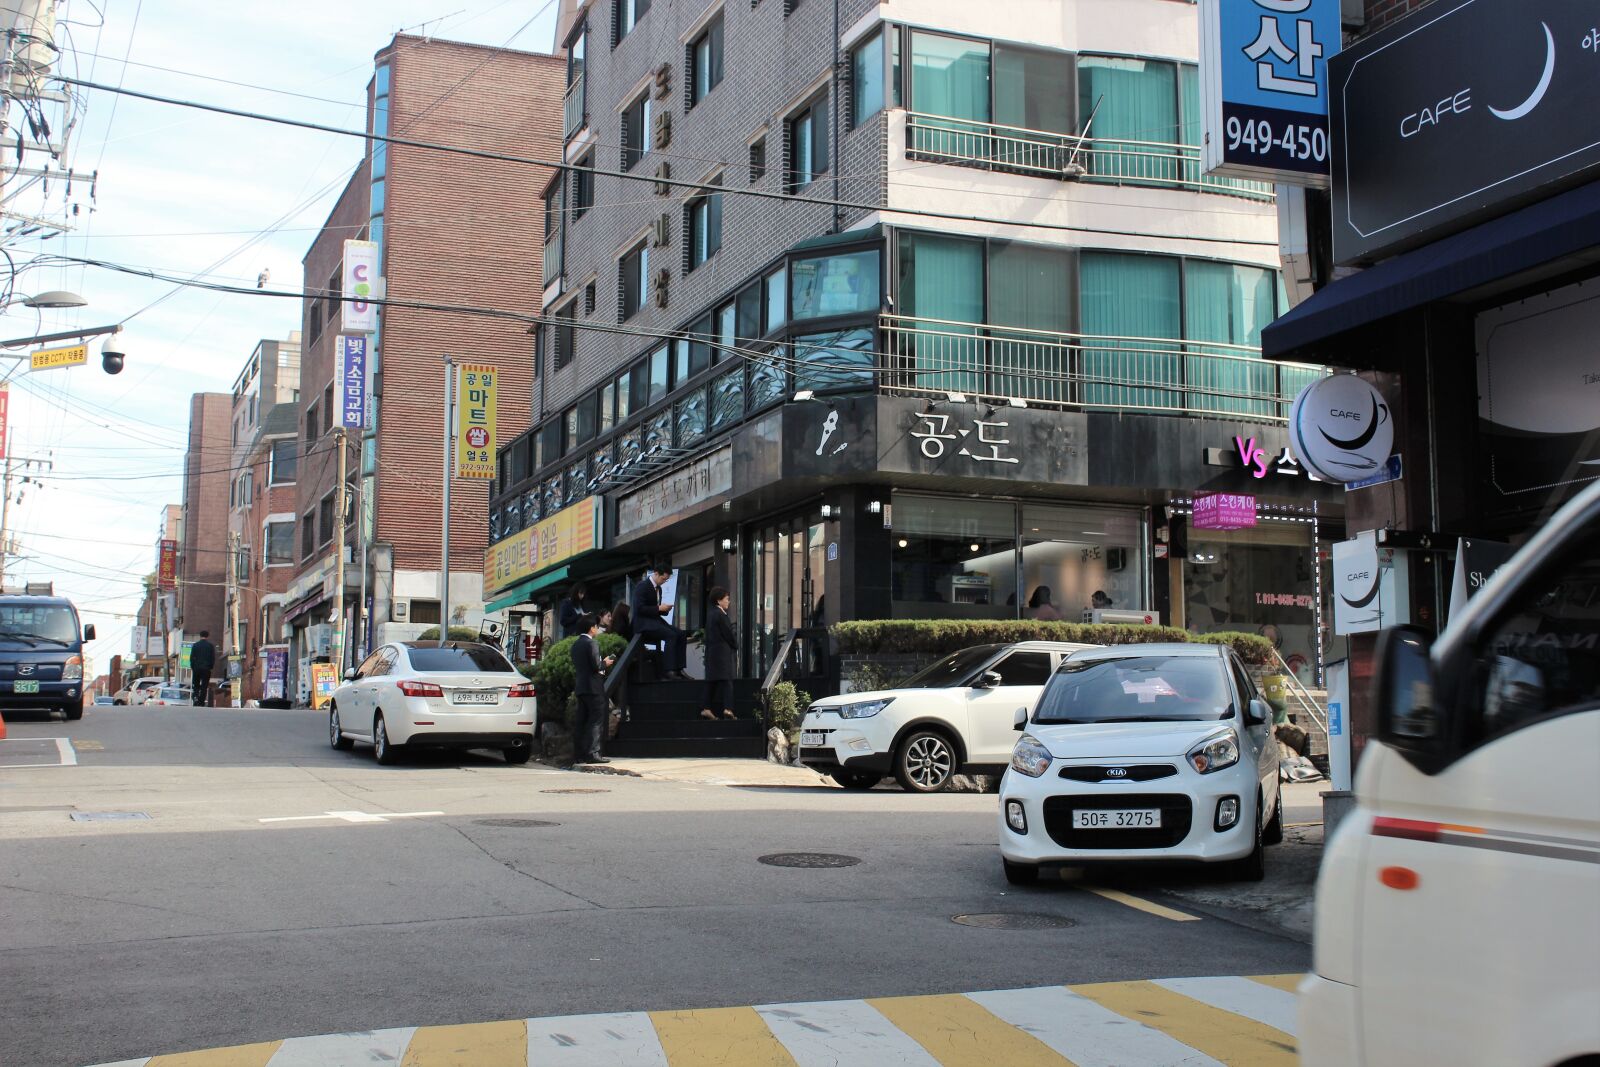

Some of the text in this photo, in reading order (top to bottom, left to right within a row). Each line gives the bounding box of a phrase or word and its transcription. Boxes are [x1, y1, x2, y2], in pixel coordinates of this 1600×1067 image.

[1400, 87, 1472, 139] CAFE
[1226, 115, 1330, 163] 949-450
[50, 351, 67, 363] CCTV
[465, 373, 493, 386] 공일
[468, 389, 489, 425] 마트
[1330, 408, 1361, 422] CAFE
[468, 428, 487, 447] 쌀
[466, 450, 489, 462] 얼음
[460, 462, 494, 472] 972-9774
[1193, 494, 1217, 512] 스킨케어
[1219, 494, 1255, 510] 스킨케어
[496, 539, 527, 580] 공일마트
[541, 523, 558, 561] 얼음
[1347, 571, 1370, 582] CAFE
[475, 694, 494, 702] 5465
[1081, 811, 1153, 826] 50주 3275
